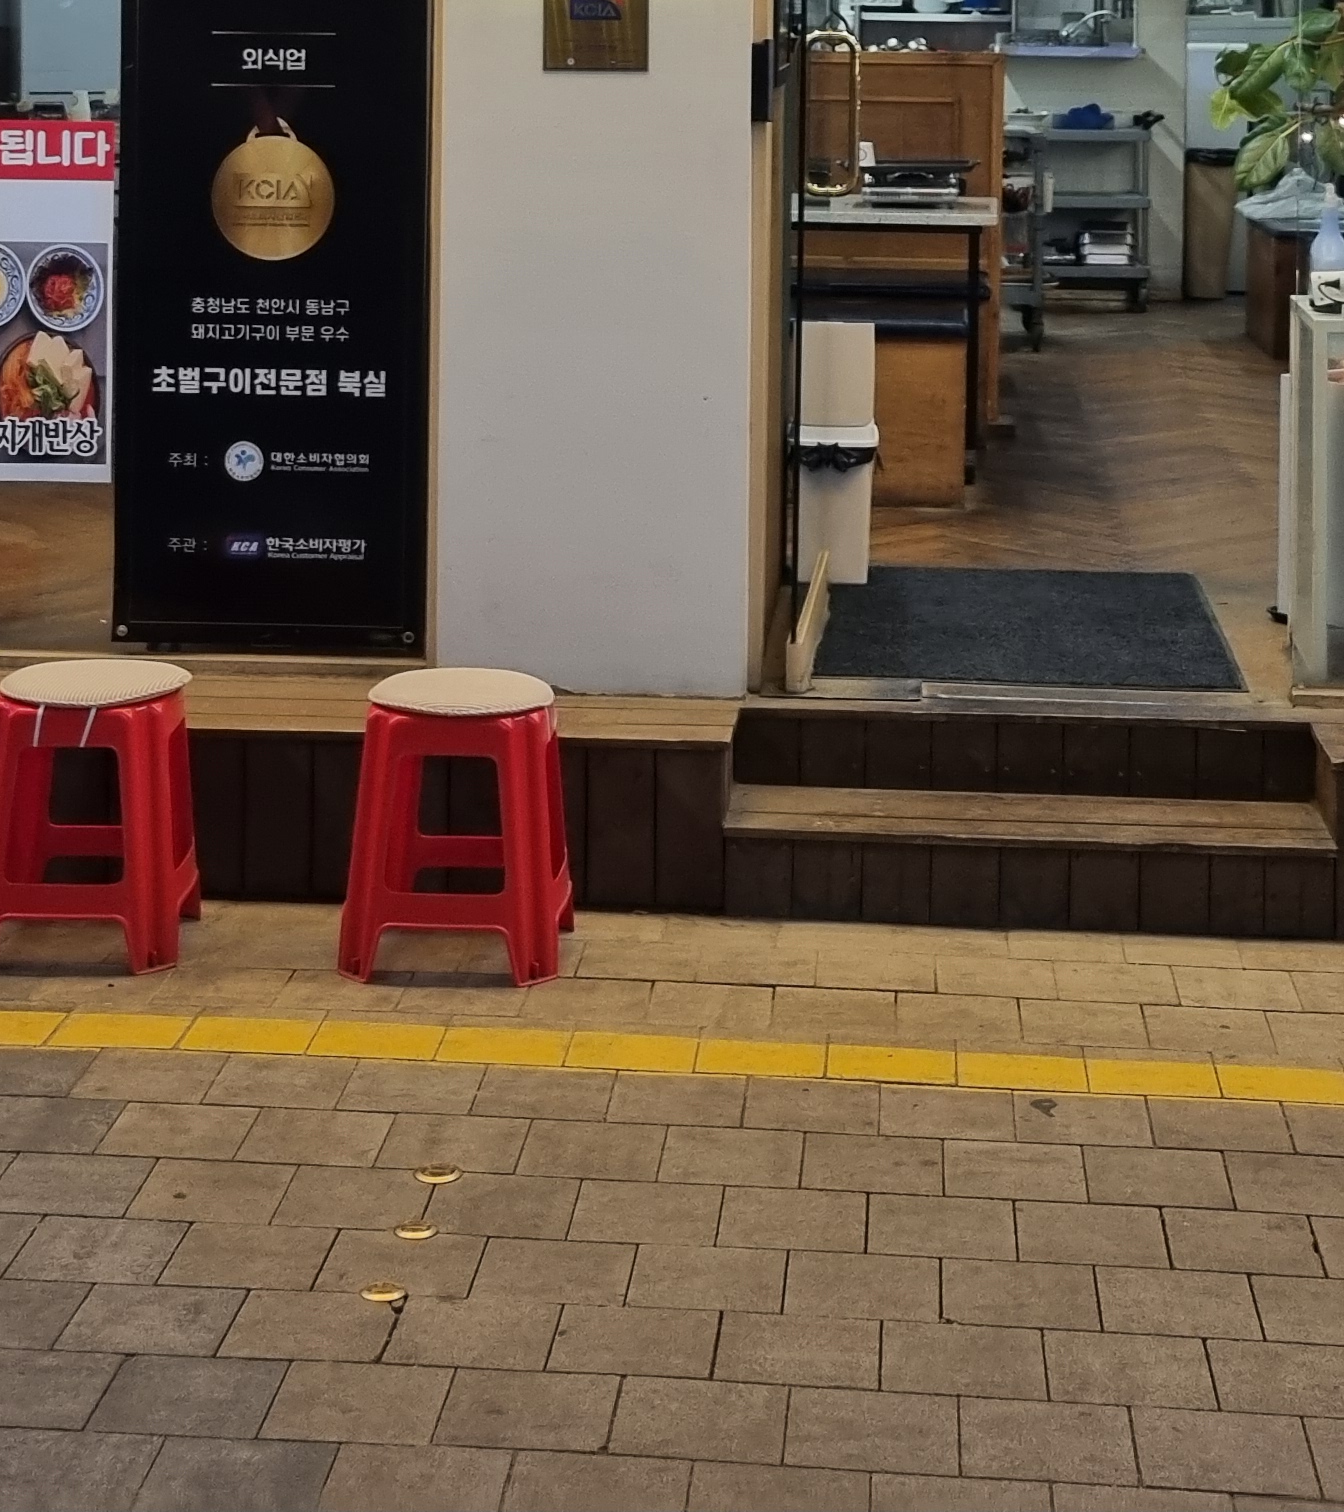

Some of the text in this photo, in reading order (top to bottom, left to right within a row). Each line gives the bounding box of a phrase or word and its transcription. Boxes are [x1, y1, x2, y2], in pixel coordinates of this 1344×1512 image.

[241, 48, 307, 72] 외식업
[239, 179, 301, 201] KCIA
[191, 296, 351, 318] 충청남도 천안시 동남구
[191, 323, 350, 344] 돼지고기구이 부문 우수
[152, 366, 387, 398] 초벌구이전문점 북실
[168, 451, 198, 469] 주최
[269, 451, 371, 467] 대한소비자협의회
[167, 537, 197, 554] 주관
[265, 536, 367, 554] 한국소비자평가
